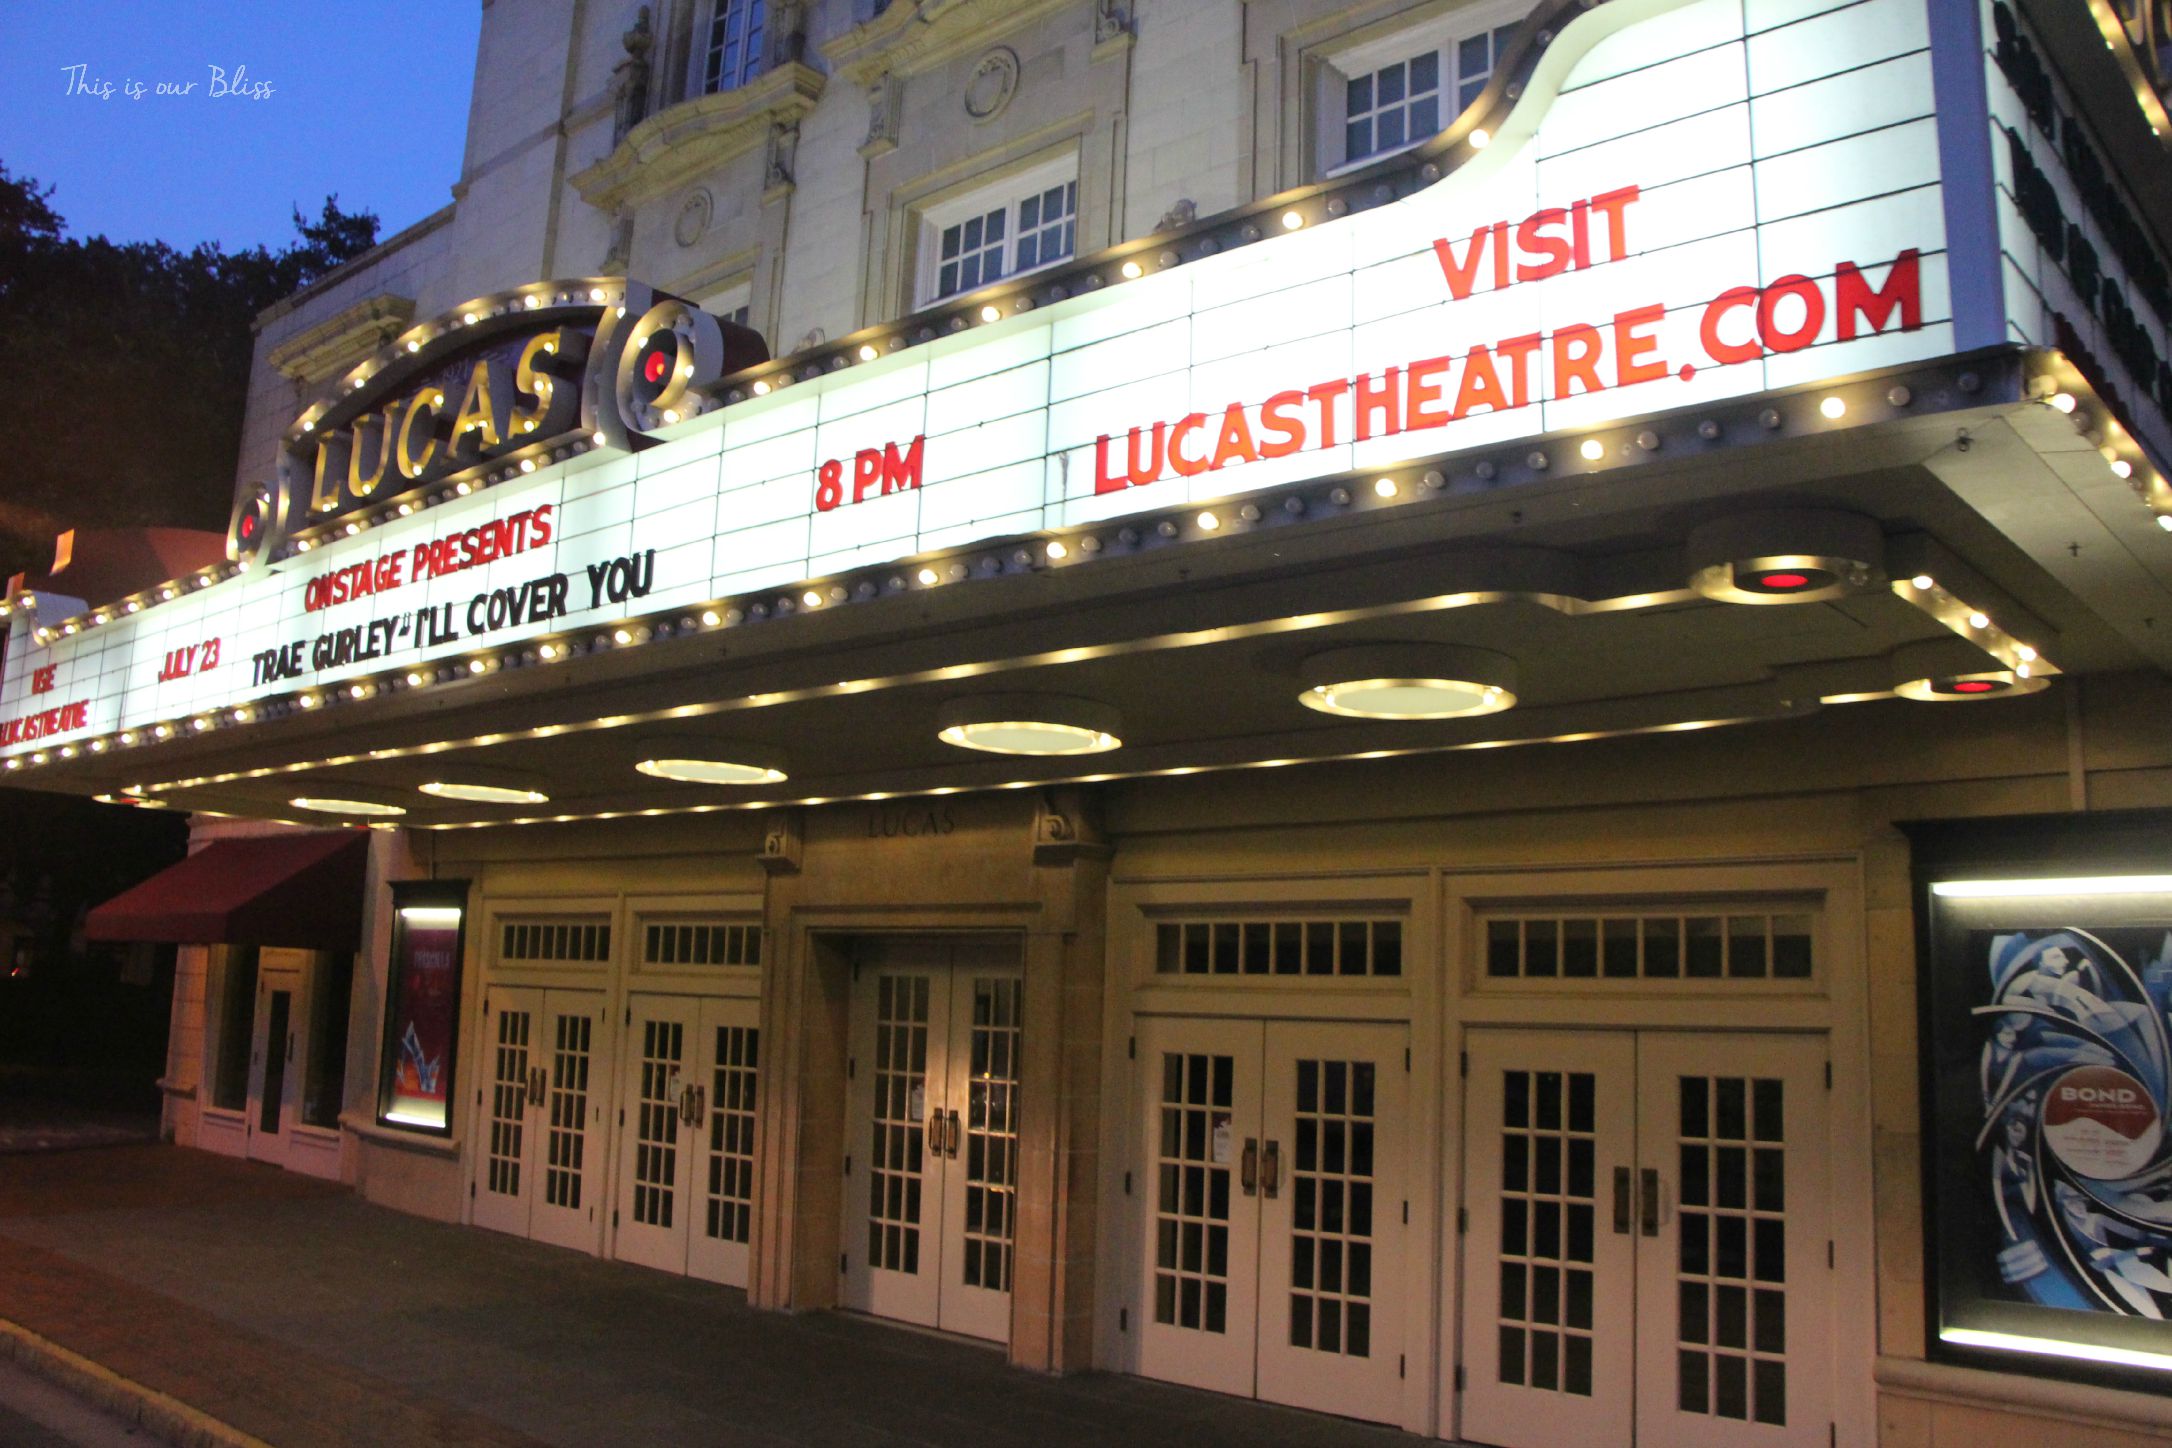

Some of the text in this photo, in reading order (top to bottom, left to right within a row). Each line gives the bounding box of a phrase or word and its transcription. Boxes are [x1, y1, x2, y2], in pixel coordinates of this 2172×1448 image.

[1433, 184, 1640, 300] VISIT
[306, 326, 562, 517] LUCAS
[1094, 248, 1922, 496] LUCASTHEATRE.COM
[815, 434, 925, 512] 8 PM
[304, 504, 554, 613] ONSTAGE PRESENTS
[158, 637, 221, 683] JULY 23
[252, 640, 306, 687] TRAE
[467, 572, 568, 636] COVER
[587, 548, 656, 609] YOU
[867, 805, 956, 838] LUCAS
[2061, 1087, 2137, 1103] BOND
